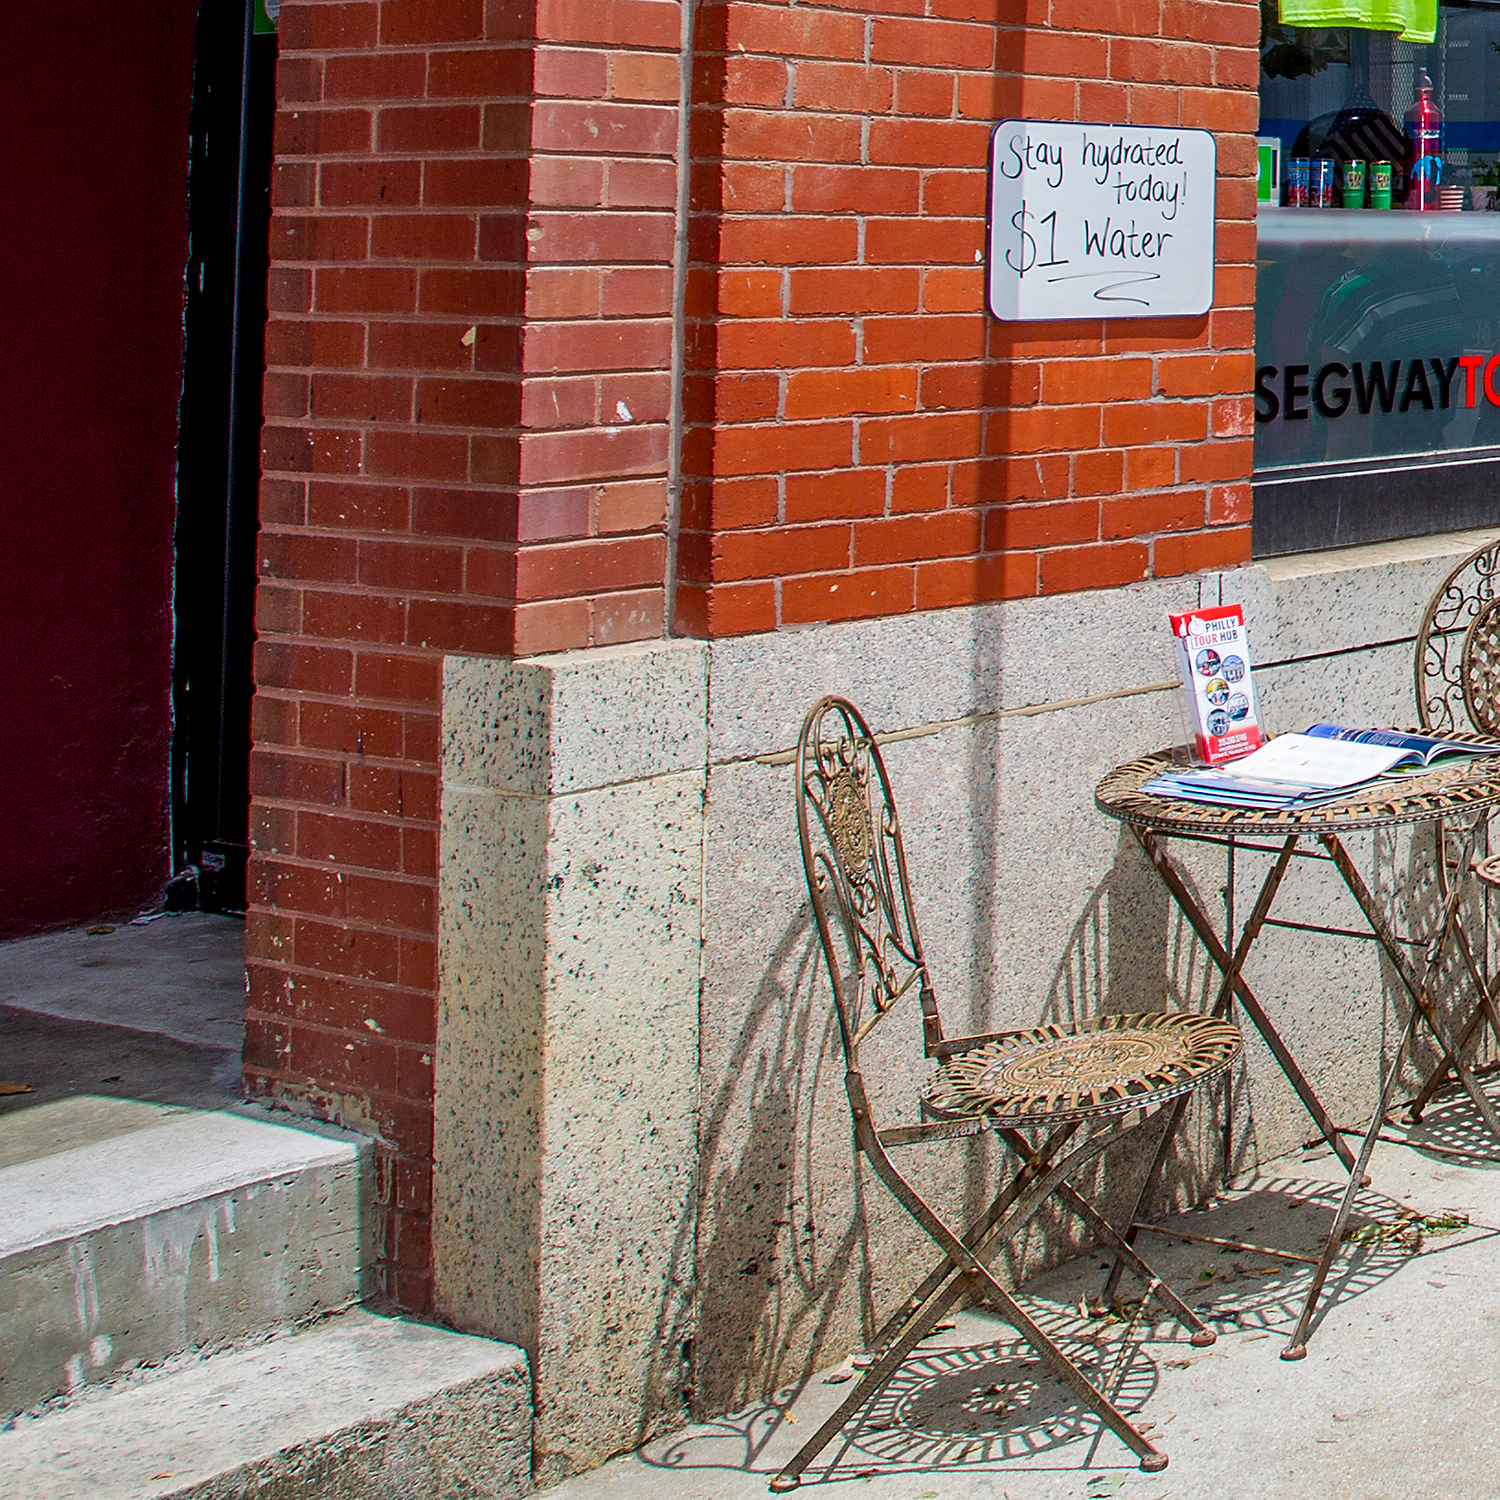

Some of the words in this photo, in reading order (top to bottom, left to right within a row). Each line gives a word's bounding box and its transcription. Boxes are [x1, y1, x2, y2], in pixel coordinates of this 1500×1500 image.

[1001, 134, 1064, 187] Stay
[1082, 132, 1183, 184] hydrated
[1112, 171, 1187, 220] today!
[1005, 200, 1069, 278] $1
[1084, 217, 1173, 258] Water
[1193, 634, 1218, 647] TOUR
[1220, 630, 1238, 642] HUB
[1205, 618, 1236, 632] PHILLY
